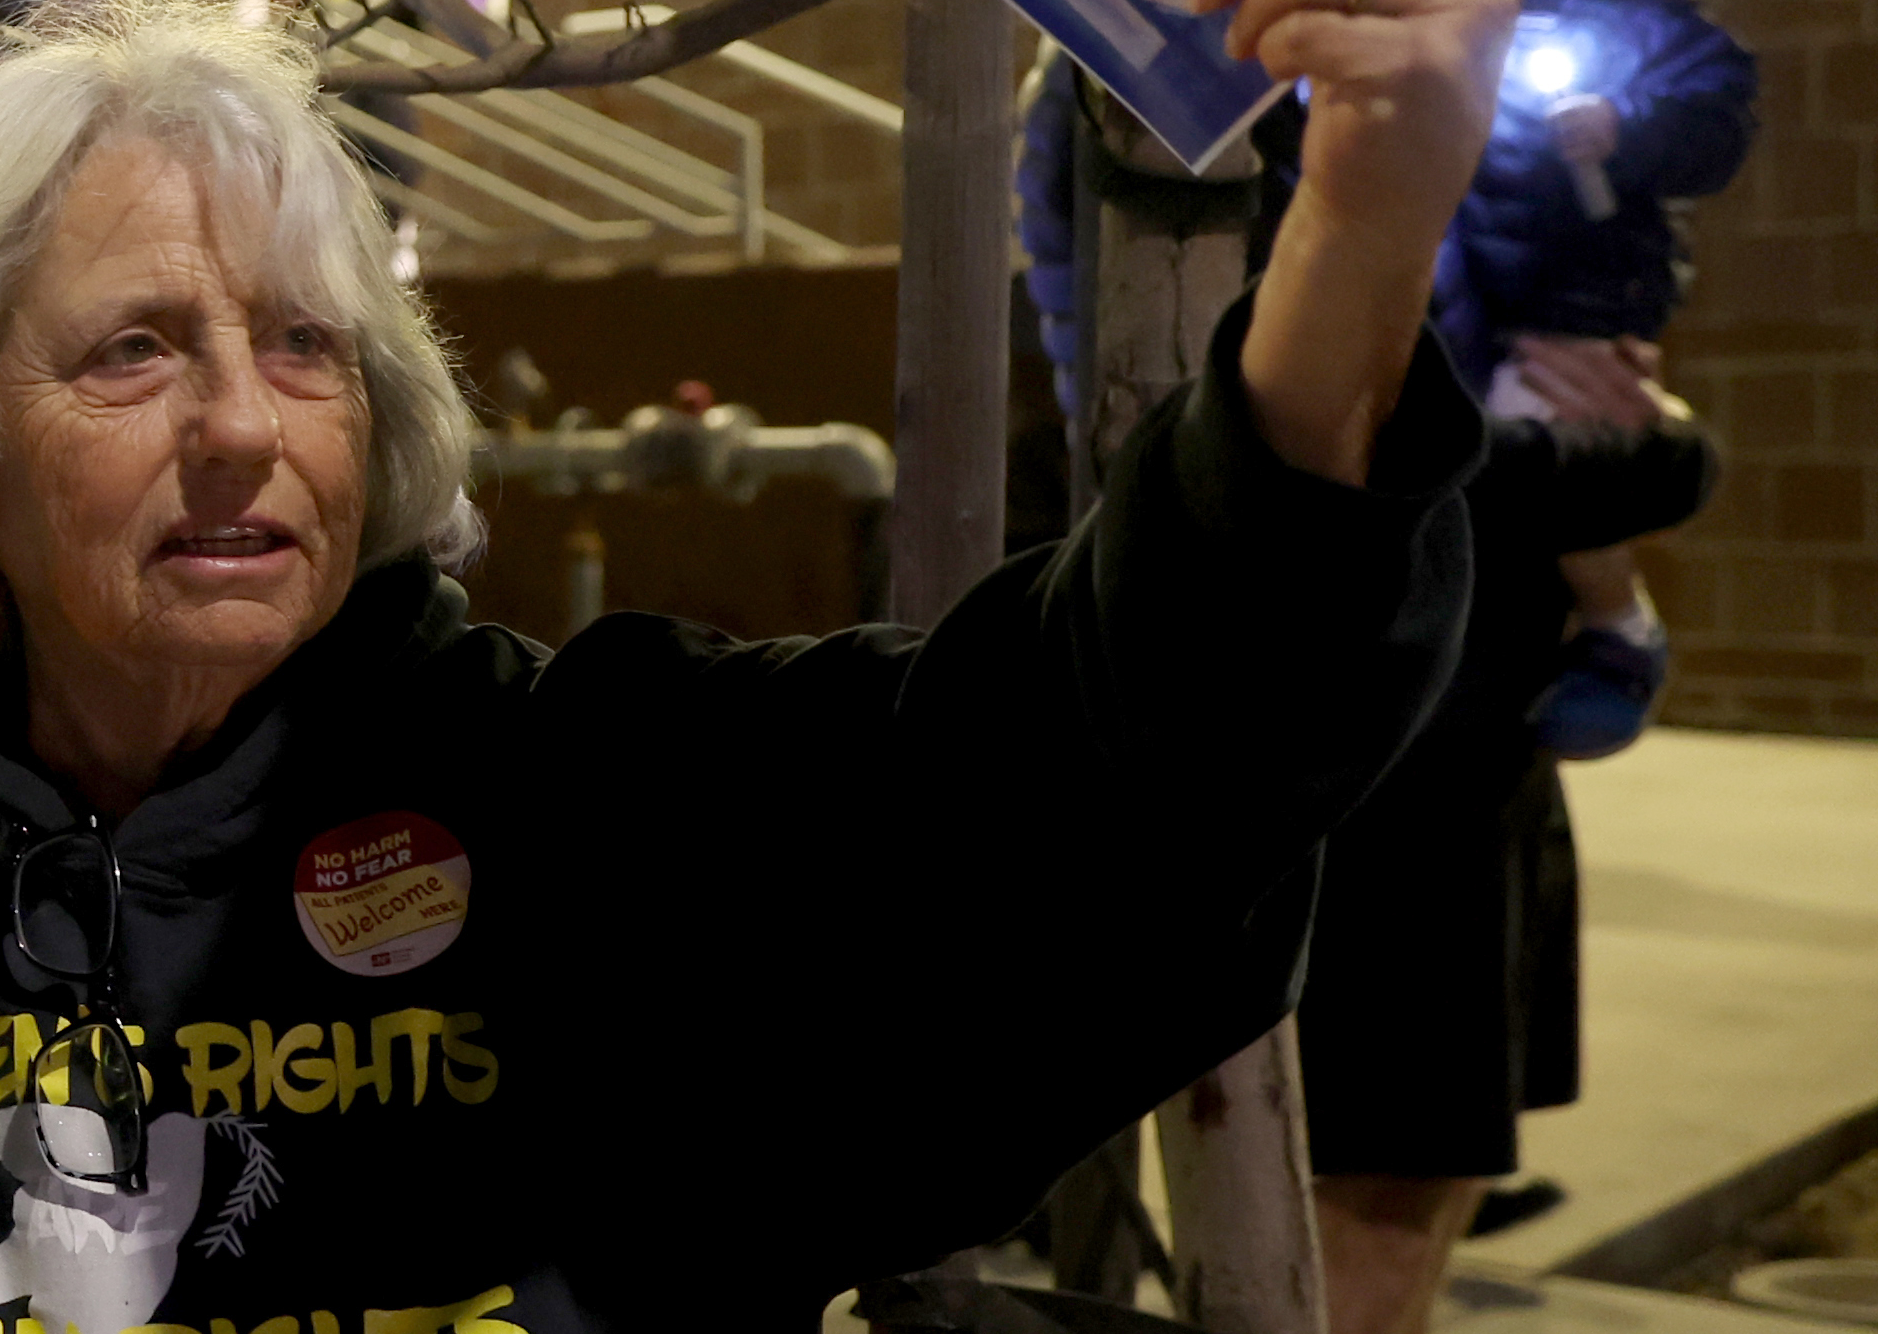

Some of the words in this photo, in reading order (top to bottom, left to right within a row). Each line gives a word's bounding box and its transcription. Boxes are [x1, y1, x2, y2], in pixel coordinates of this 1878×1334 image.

[314, 852, 345, 869] NO
[350, 828, 412, 864] HARM
[315, 870, 349, 888] NO
[354, 848, 412, 882] FEAR
[310, 897, 333, 908] ALL
[324, 875, 444, 946] Welcome
[175, 1007, 500, 1119] RIGHTS
